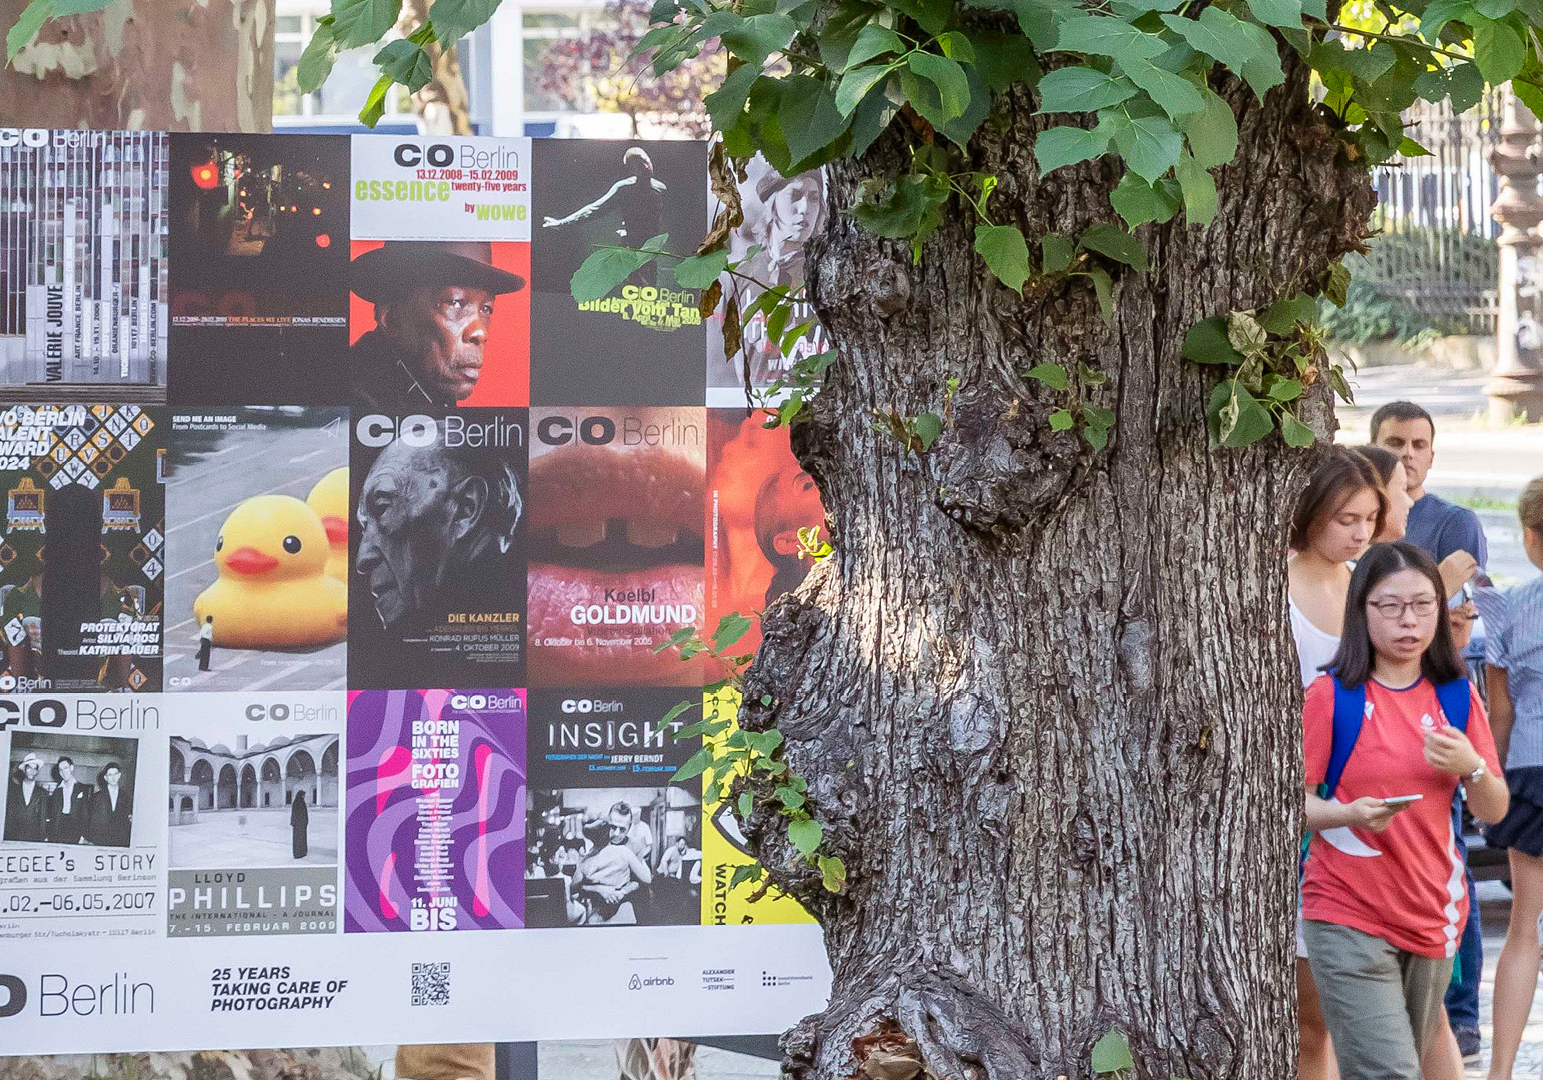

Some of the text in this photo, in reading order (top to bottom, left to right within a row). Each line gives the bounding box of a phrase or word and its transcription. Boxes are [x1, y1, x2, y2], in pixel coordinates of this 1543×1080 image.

[53, 129, 106, 149] Berlin
[460, 144, 519, 169] Berlin
[355, 180, 527, 201] essence twenty-five years
[464, 202, 527, 221] by wowe
[659, 287, 695, 304] Berlin
[46, 285, 63, 328] JOUVE
[670, 303, 701, 318] Tan
[74, 285, 82, 359] ART FRANCE BERLIN
[292, 316, 311, 324] JONAS
[312, 316, 346, 324] BENDIKSEN
[22, 411, 87, 427] BERLIN
[172, 415, 237, 423] SEND ME AN IMAGE
[445, 415, 522, 448] Berlin
[623, 416, 699, 446] Berlin
[604, 587, 655, 602] Koelbl
[448, 613, 520, 623] DIE KANZLER
[570, 604, 697, 625] GOLDMUND
[80, 622, 160, 633] PROTEKTORAT
[97, 633, 131, 643] SILVIA
[132, 633, 160, 643] ROSI
[463, 634, 488, 642] RUFUS
[489, 633, 520, 642] MÜLLER
[544, 637, 572, 647] Oktober
[574, 637, 585, 646] bis
[595, 637, 632, 646] November
[79, 645, 121, 655] KATRIN
[121, 645, 160, 655] BAUER
[463, 644, 499, 652] OKTOBER
[17, 676, 52, 689] Berlin
[487, 695, 522, 709] Berlin
[593, 699, 624, 713] Berlin
[76, 699, 159, 730] Berlin
[293, 703, 338, 721] Berlin
[411, 720, 460, 735] BORN
[549, 721, 684, 748] INSIGHT
[411, 735, 459, 747] IN THE
[411, 747, 459, 759] SIXTIES
[610, 754, 633, 764] JERRY
[633, 753, 664, 763] BERNDT
[411, 763, 460, 779] FOTO
[411, 778, 460, 789] GRAFIEN
[94, 854, 156, 871] STORY
[53, 875, 68, 883] der
[73, 874, 113, 883] Sammlung
[117, 874, 157, 882] Berinson
[195, 873, 246, 884] LLOYD
[169, 885, 337, 910] PHILLIPS
[411, 896, 458, 908] 11. JUNI
[191, 912, 268, 920] INTERNATIONAL
[292, 910, 335, 918] JOURNAL
[410, 907, 458, 931] BIS
[226, 922, 290, 932] FEBRUAR
[299, 921, 336, 930] 2009
[211, 966, 291, 981] 25 YEARS
[643, 976, 675, 986] airbnb
[40, 972, 156, 1018] Berlin
[211, 979, 348, 997] TAKING CARE OF
[210, 996, 335, 1012] PHOTOGRAPHY
